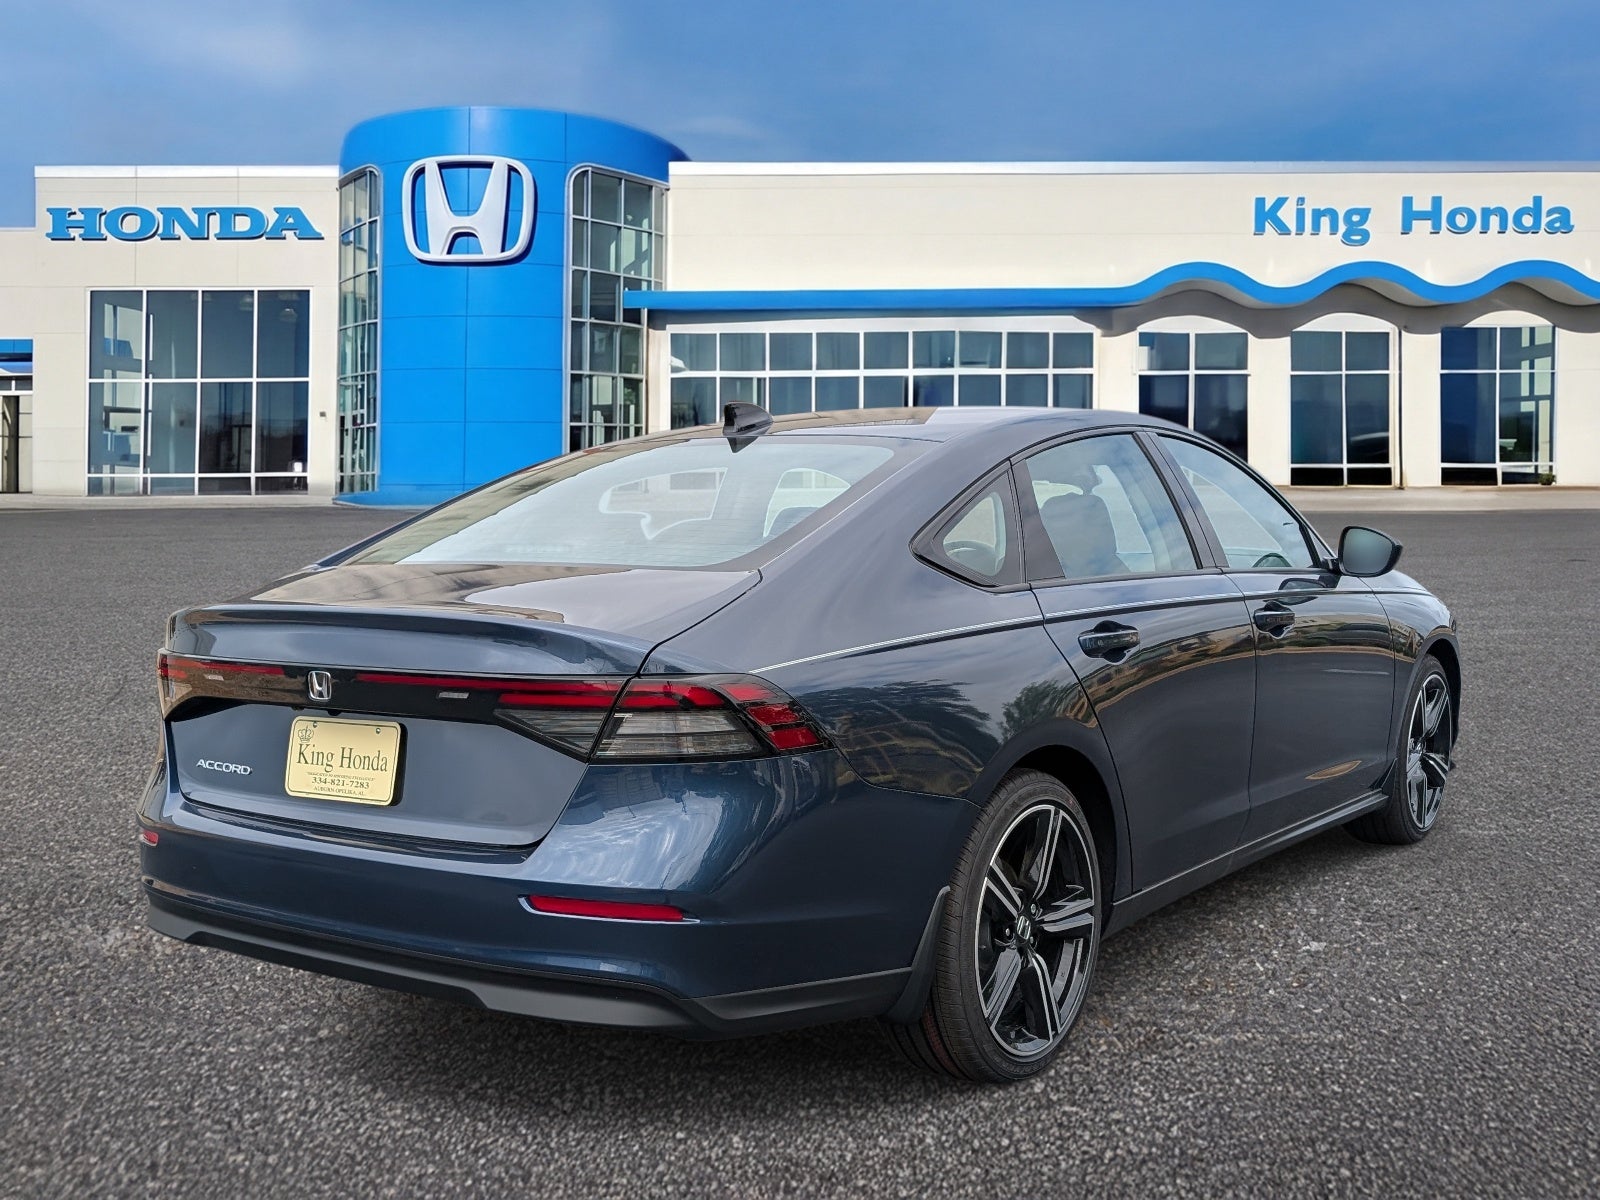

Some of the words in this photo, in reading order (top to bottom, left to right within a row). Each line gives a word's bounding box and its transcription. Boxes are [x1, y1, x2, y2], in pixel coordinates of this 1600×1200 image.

[46, 206, 325, 241] HONDA
[1253, 197, 1372, 246] King
[1400, 195, 1575, 236] Honda
[196, 759, 252, 775] ACCORD
[296, 743, 335, 772] King
[339, 747, 388, 772] Honda
[311, 776, 370, 789] 334-821-7283
